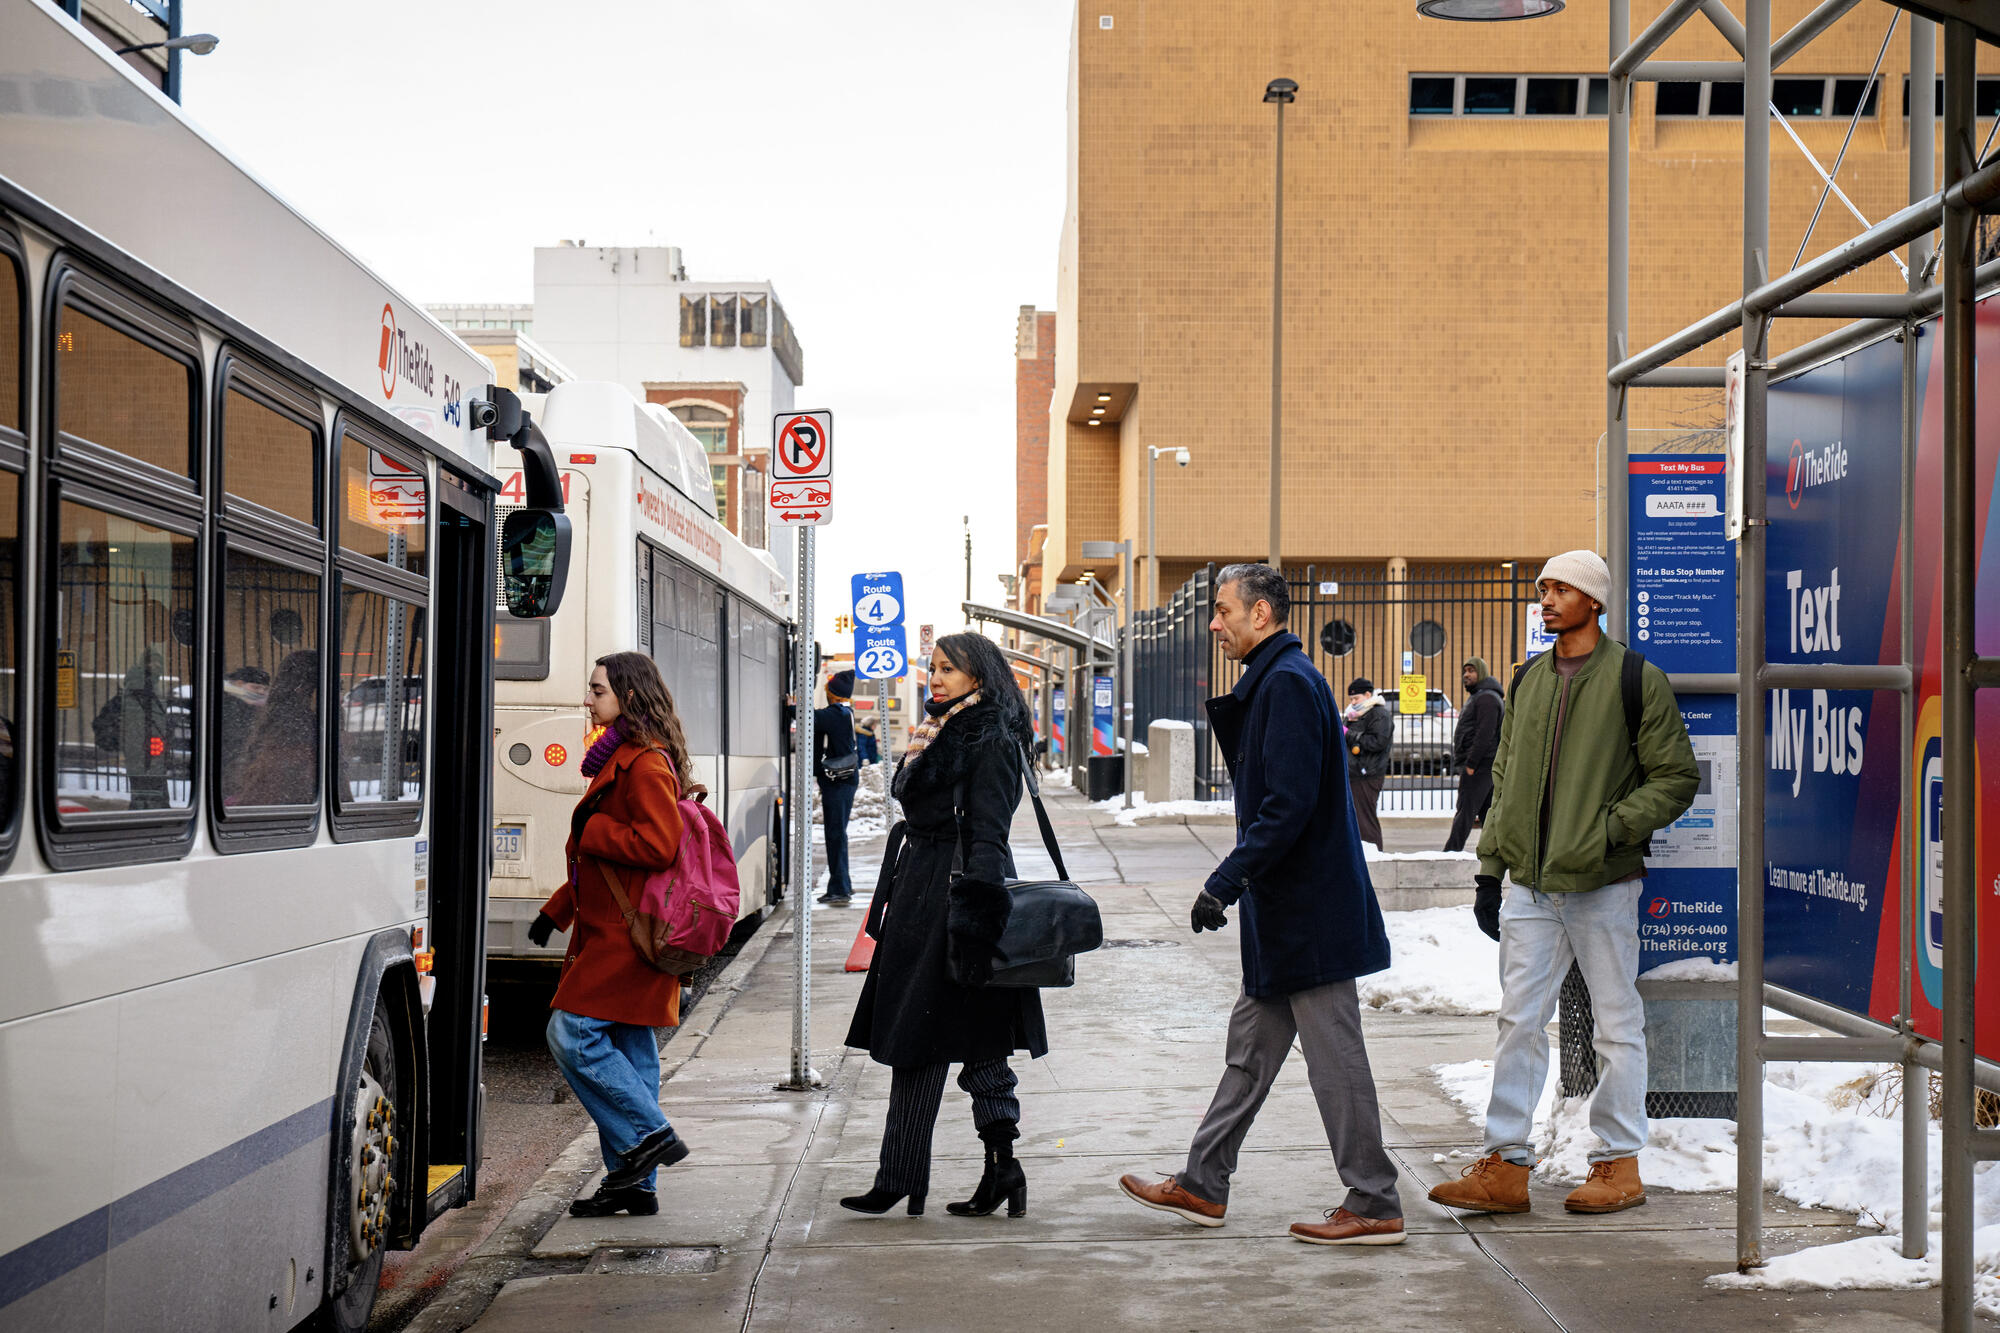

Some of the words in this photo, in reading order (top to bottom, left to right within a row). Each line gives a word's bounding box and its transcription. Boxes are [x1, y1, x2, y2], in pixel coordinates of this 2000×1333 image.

[398, 328, 434, 398] TheRide
[444, 374, 461, 428] 548
[1678, 464, 1689, 472] My
[1805, 441, 1848, 488] TheRide
[500, 472, 570, 504] 41
[1676, 568, 1694, 577] Stop
[863, 585, 891, 594] Route
[869, 600, 884, 621] 4
[1787, 566, 1841, 654] Text
[867, 638, 895, 648] Route
[866, 650, 896, 673] 23
[1771, 689, 1806, 798] My
[1812, 689, 1864, 776] Bus
[496, 837, 518, 852] 219
[1769, 861, 1787, 889] Learn
[1789, 870, 1807, 894] more
[1808, 870, 1816, 895] at
[1817, 869, 1868, 912] TheRide.org.
[1672, 902, 1723, 913] TheRide
[1642, 924, 1671, 935] (734)
[1673, 925, 1728, 935] 996-0400
[1641, 940, 1727, 953] TheRide.org
